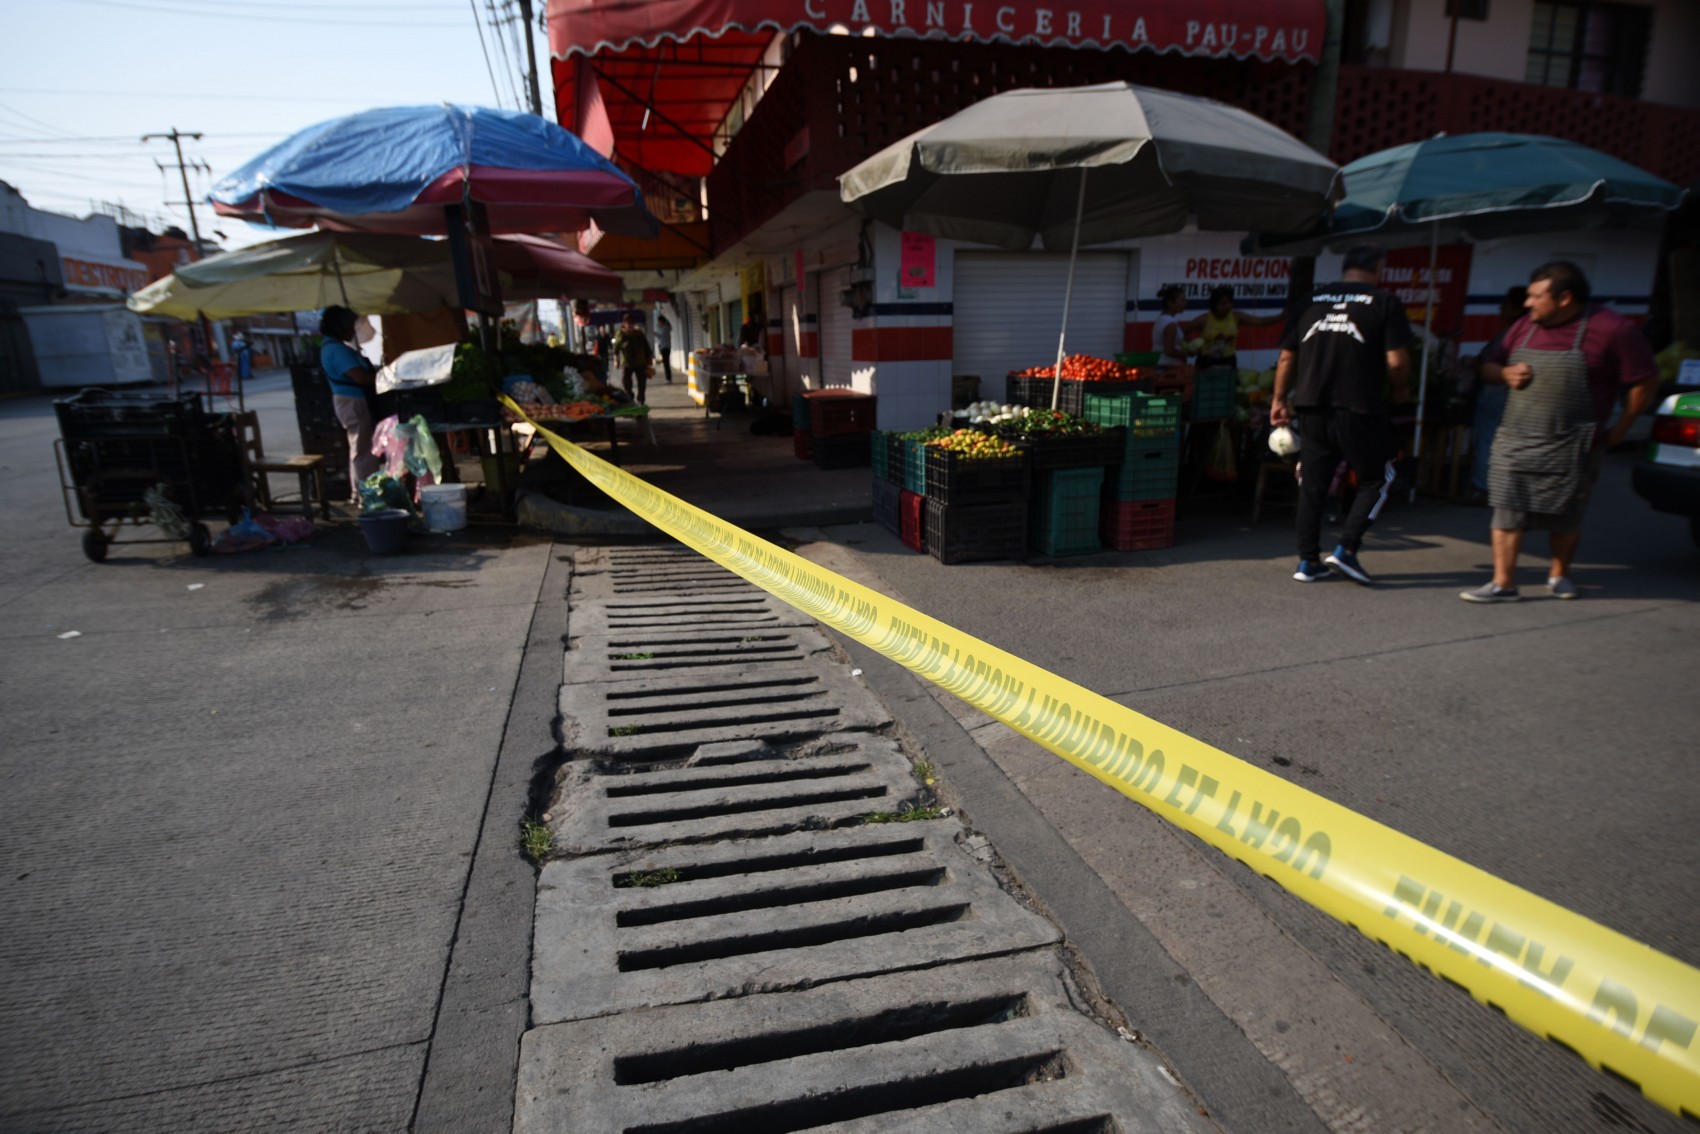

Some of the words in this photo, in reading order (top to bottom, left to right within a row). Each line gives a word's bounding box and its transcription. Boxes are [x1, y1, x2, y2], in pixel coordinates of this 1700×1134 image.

[804, 0, 1149, 43] CARNICERIA
[1185, 19, 1310, 52] PAU-PAU
[1185, 257, 1293, 280] PRECAUCION
